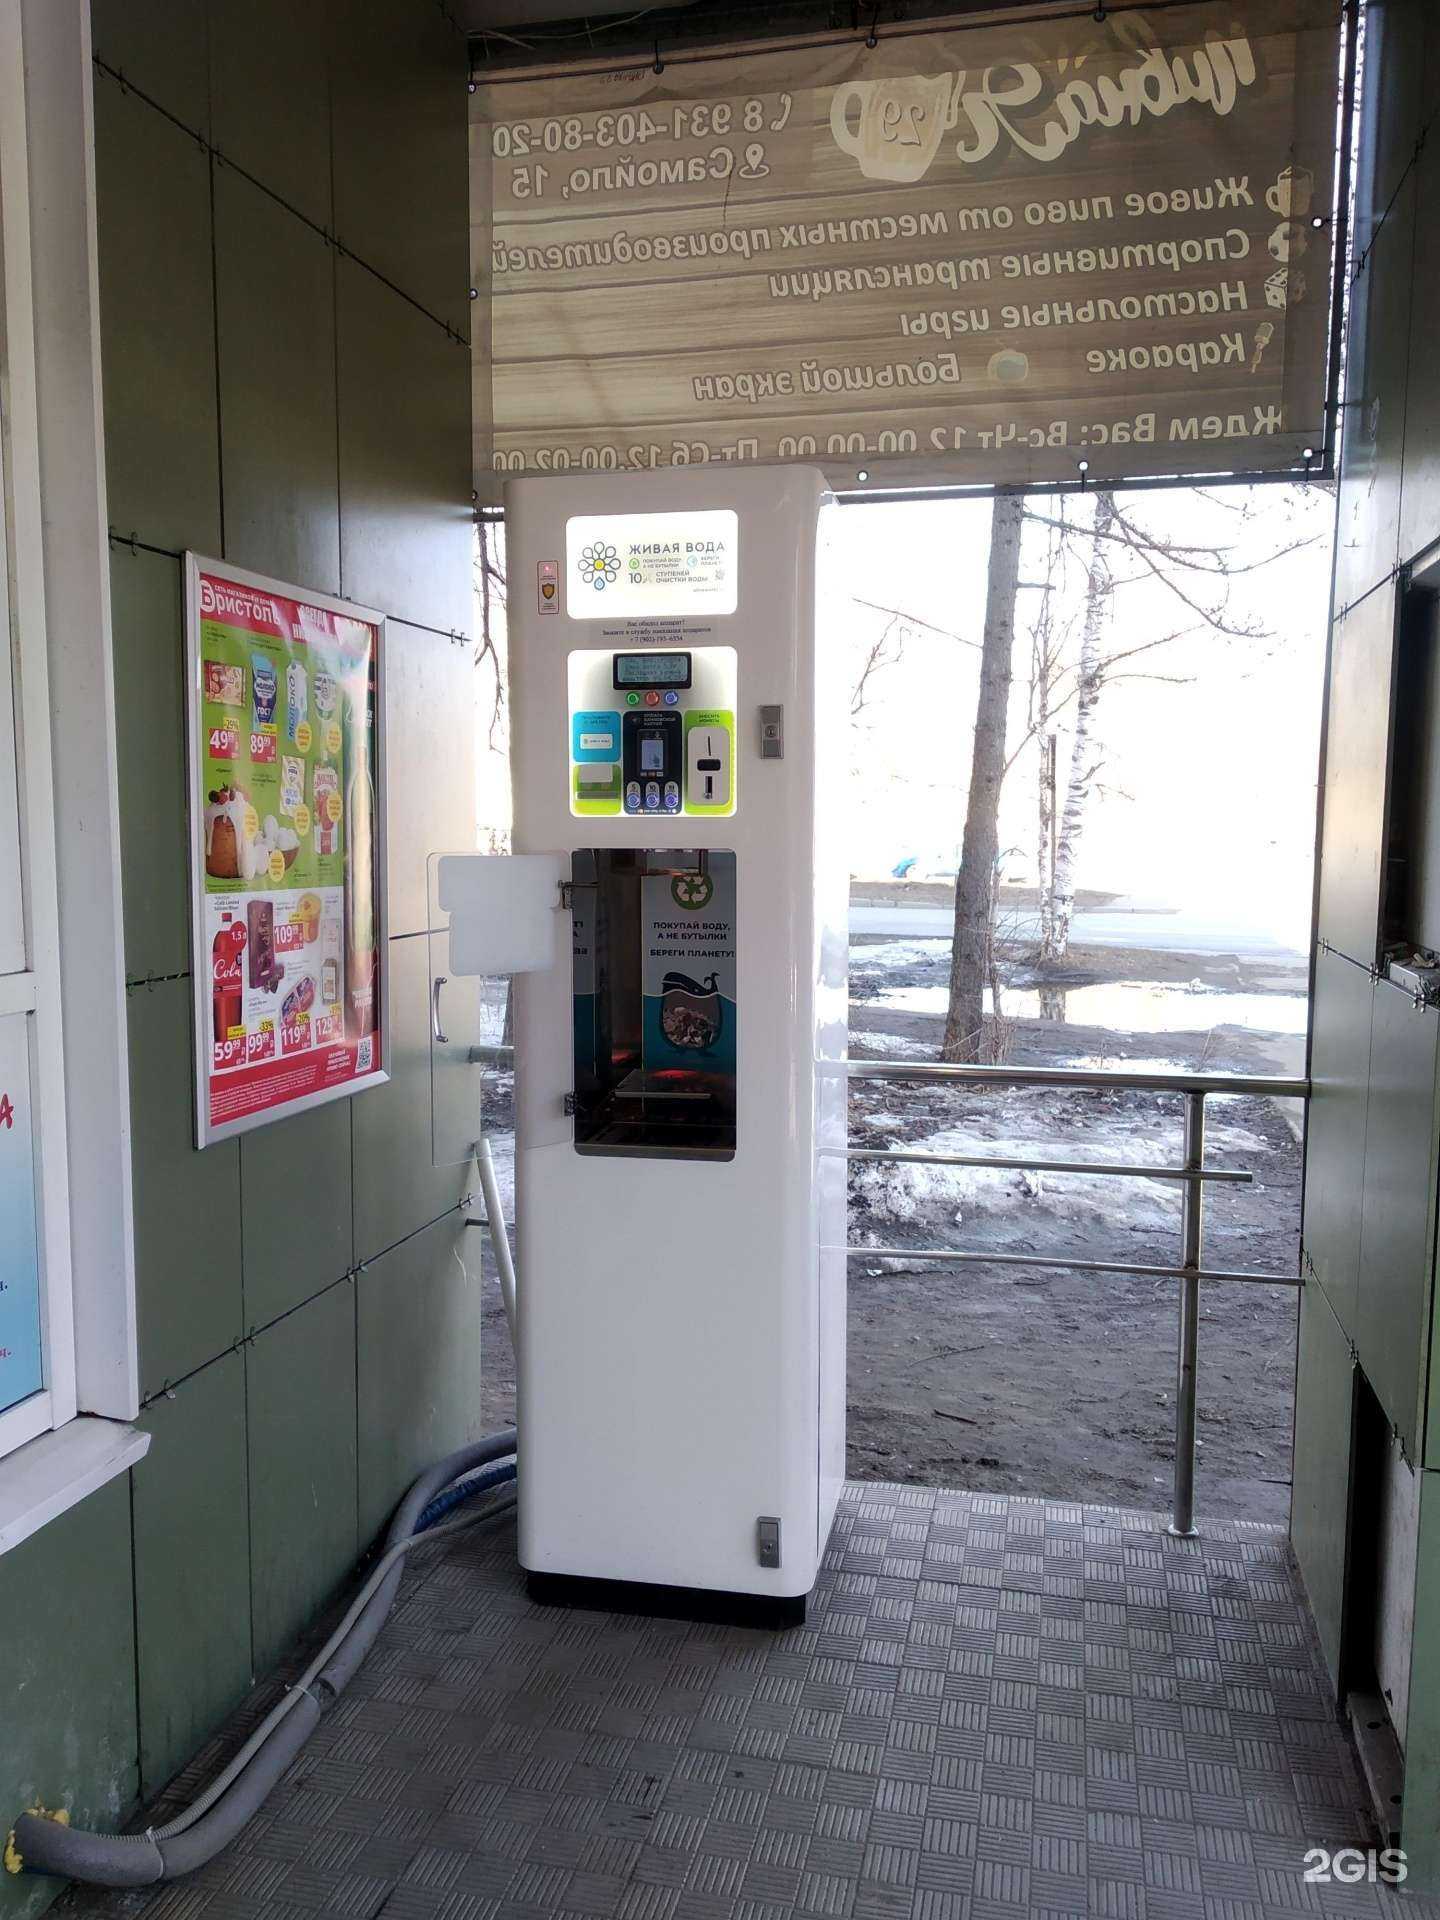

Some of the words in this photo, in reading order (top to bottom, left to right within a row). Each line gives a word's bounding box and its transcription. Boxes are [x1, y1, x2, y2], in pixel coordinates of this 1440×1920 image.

[629, 543, 680, 555] ЖИВАЯ
[686, 541, 725, 553] ВОДА
[629, 573, 642, 584] 10
[653, 921, 700, 930] ПОКУПАЙ
[681, 933, 727, 941] БУТЫЛКИ
[650, 949, 685, 957] БЕРЕГИ
[214, 958, 241, 979] Cola
[214, 1041, 233, 1061] 59
